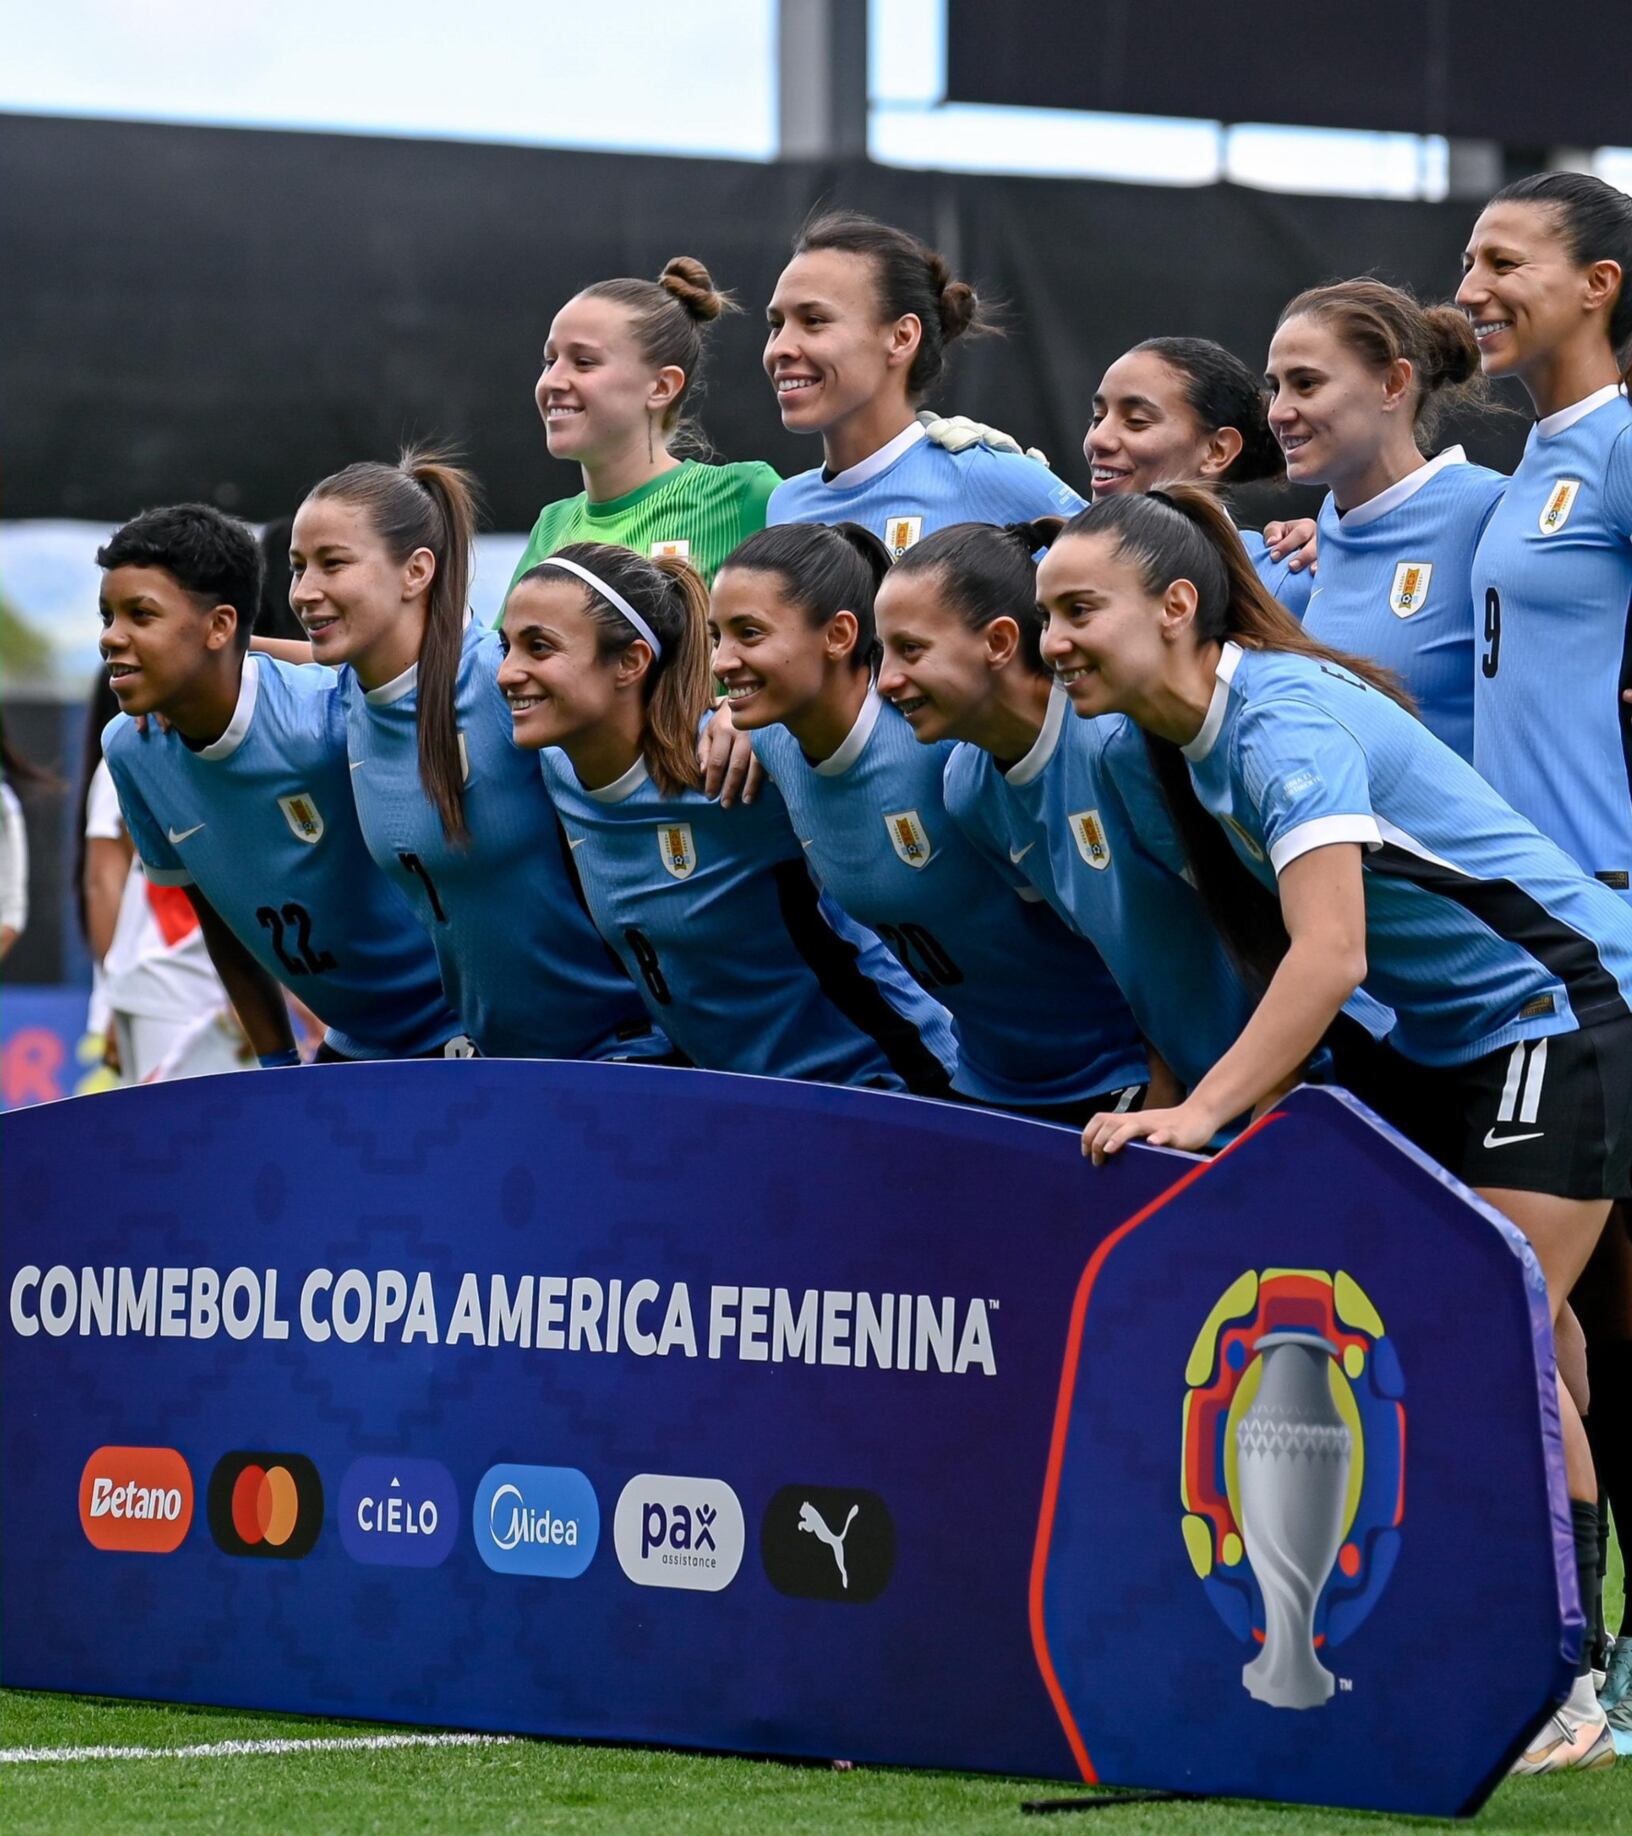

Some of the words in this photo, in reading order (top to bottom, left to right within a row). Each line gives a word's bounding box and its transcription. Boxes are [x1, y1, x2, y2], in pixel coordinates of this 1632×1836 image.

[1481, 586, 1502, 679] 9
[255, 903, 338, 976] 22
[623, 928, 672, 1006] 8
[876, 923, 964, 990] 20
[1496, 1037, 1548, 1124] 11
[9, 1265, 289, 1340] CONMEBOL
[299, 1268, 439, 1344] COPA
[445, 1272, 698, 1358] AMERICA
[708, 1285, 997, 1376] FEMENINA
[90, 1477, 182, 1521] Betano
[357, 1497, 438, 1535] CIELO
[490, 1484, 578, 1550] Midea
[641, 1503, 717, 1559] pax
[662, 1553, 717, 1568] assistance
